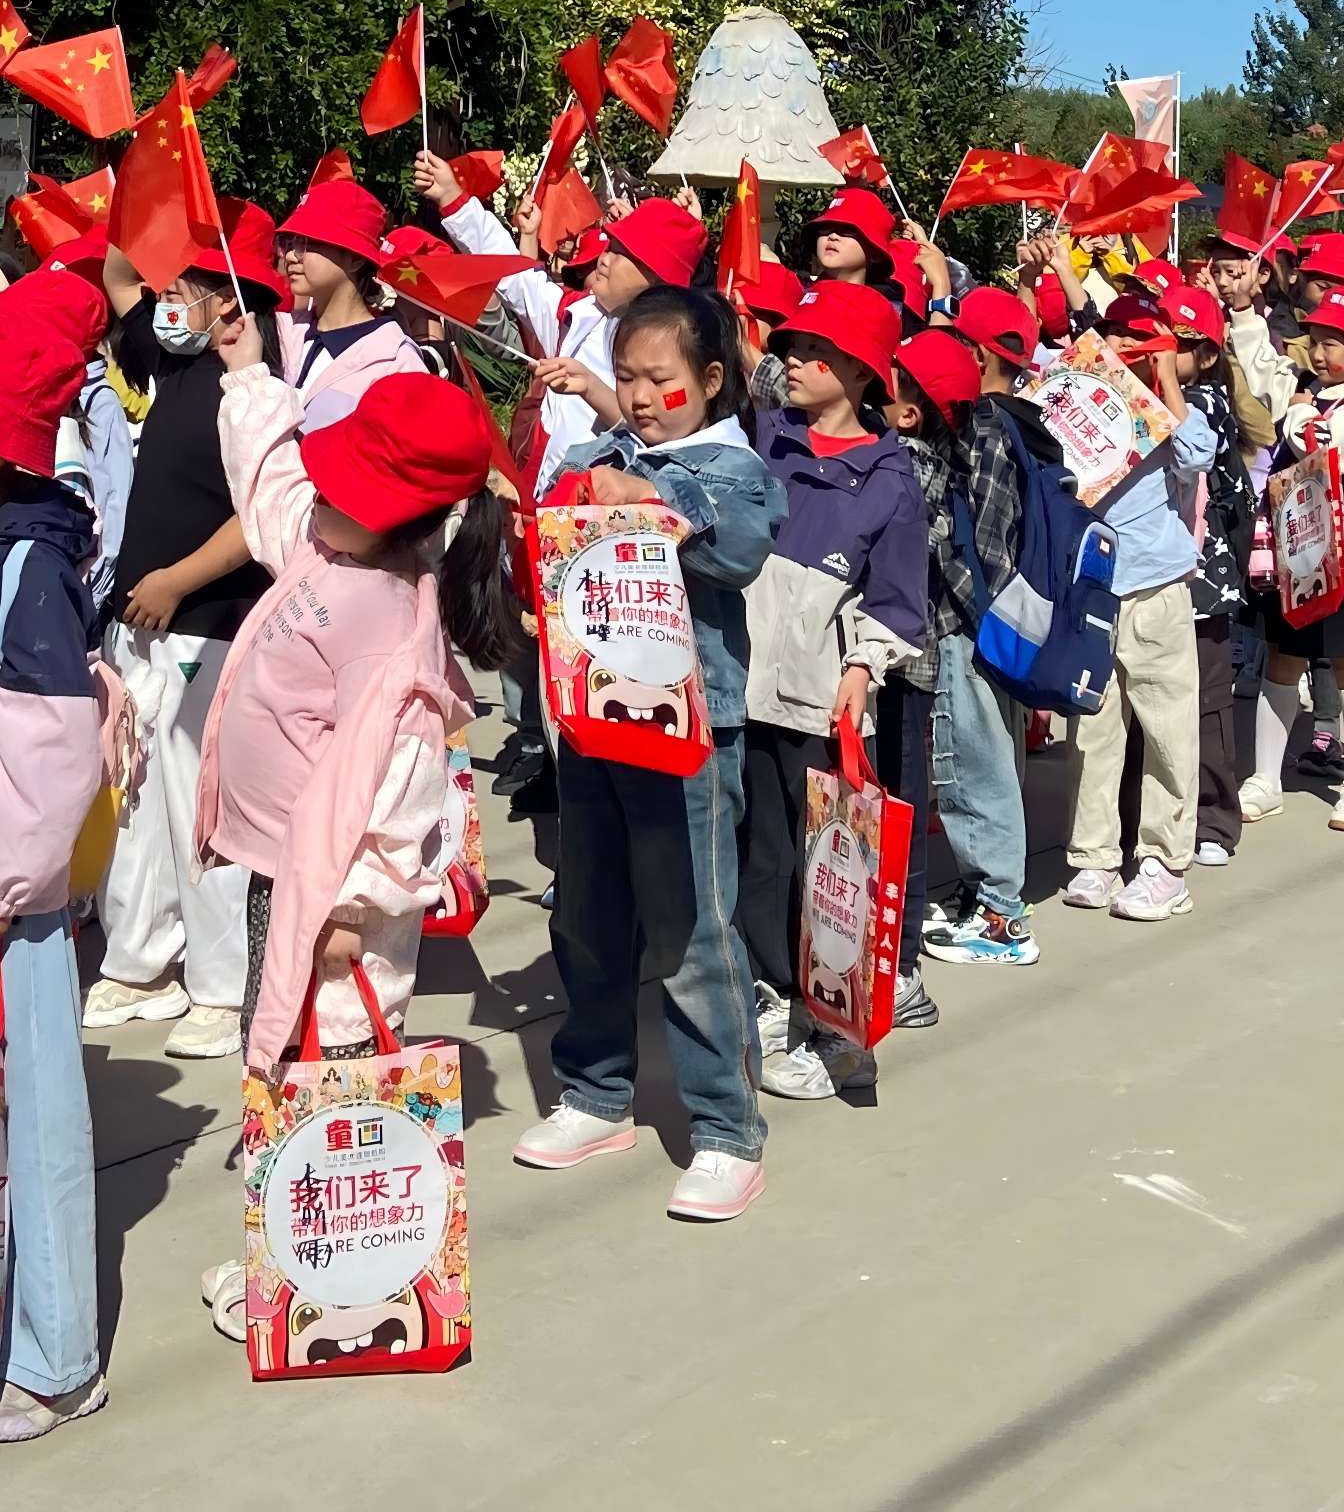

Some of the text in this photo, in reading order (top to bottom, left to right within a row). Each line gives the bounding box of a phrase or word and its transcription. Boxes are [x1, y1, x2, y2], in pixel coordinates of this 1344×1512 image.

[584, 578, 687, 613] 我们来了
[313, 605, 333, 628] May
[617, 624, 644, 638] ARE
[647, 627, 690, 650] COMING
[814, 861, 860, 909] 我们来了
[289, 1164, 422, 1213] 我们来了
[290, 1202, 425, 1239] 带着你的想象力
[325, 1237, 355, 1255] ARE
[361, 1227, 425, 1250] COMING
